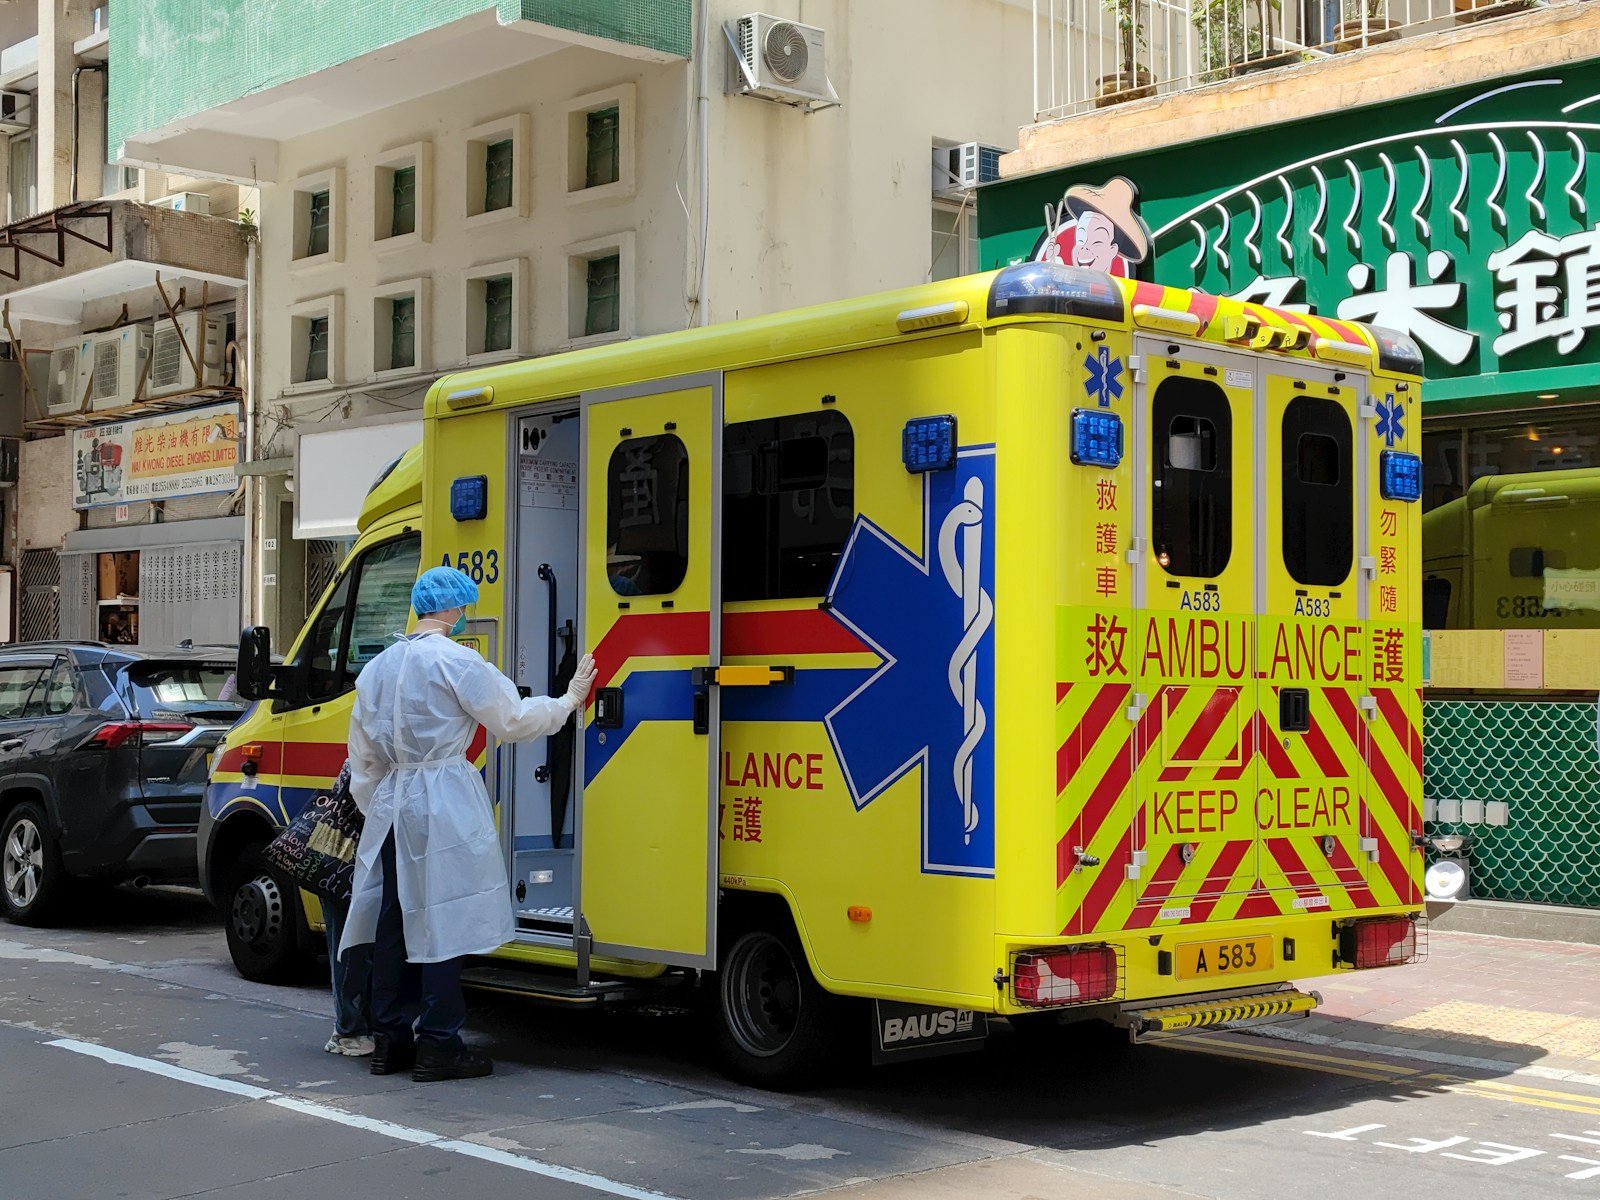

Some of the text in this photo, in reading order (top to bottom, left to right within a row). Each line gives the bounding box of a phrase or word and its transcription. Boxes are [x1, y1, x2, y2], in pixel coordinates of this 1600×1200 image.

[134, 420, 235, 454] 維光柴油機有限司
[132, 447, 236, 473] WAI KWONG DIESEL ENGINES LIMITED
[1096, 478, 1117, 598] 救護車
[1380, 508, 1396, 613] 勿緊隨
[1180, 591, 1220, 612] A583
[1294, 597, 1330, 618] A583
[1085, 613, 1127, 677] 救
[1141, 617, 1362, 681] AMBULANCE
[1372, 628, 1405, 684] 護
[720, 751, 823, 790] LANCE
[1153, 786, 1351, 835] KEEP CLEAR
[1196, 943, 1257, 973] A 583
[884, 1010, 956, 1043] BAUS
